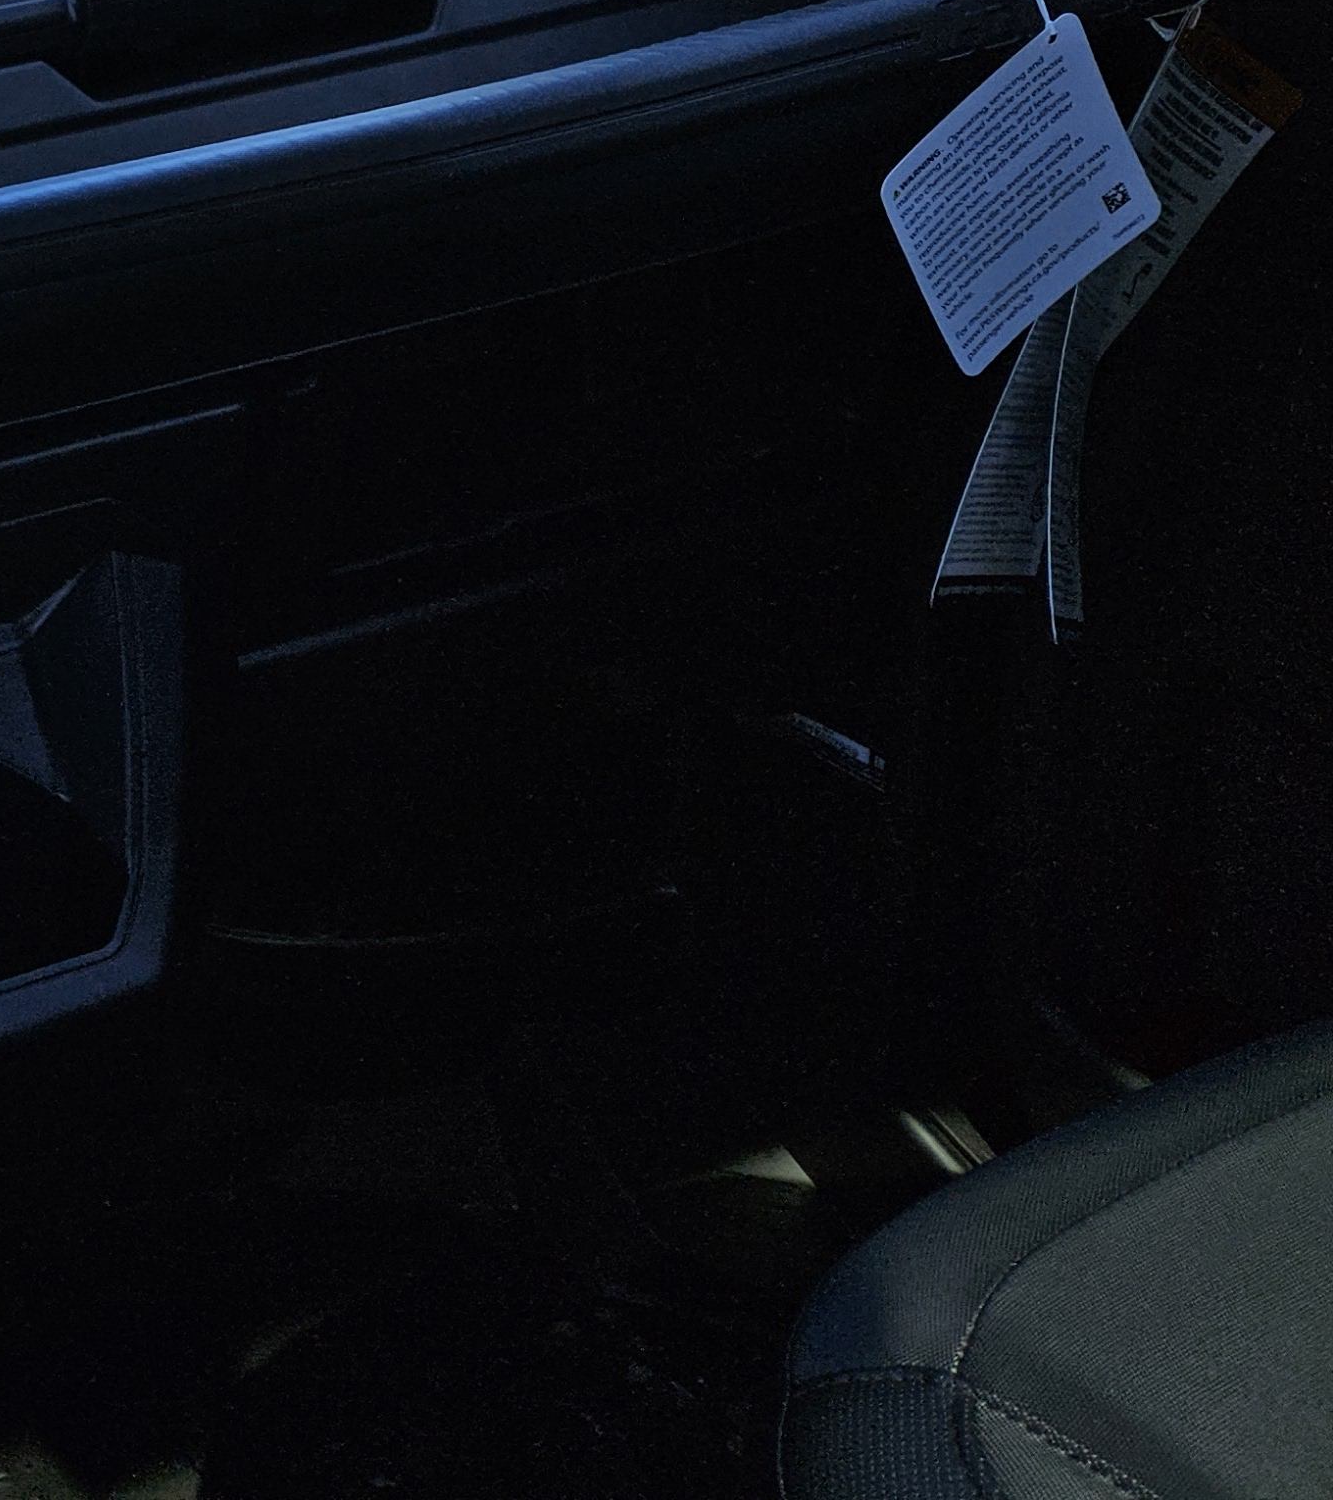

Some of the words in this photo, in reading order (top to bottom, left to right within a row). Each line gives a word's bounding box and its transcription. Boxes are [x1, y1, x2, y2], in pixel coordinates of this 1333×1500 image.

[895, 162, 942, 210] maintaining
[985, 95, 1015, 123] vehicle
[1014, 81, 1032, 97] can
[1031, 55, 1064, 83] expose
[988, 71, 1027, 106] servicing
[1026, 54, 1045, 74] and
[899, 203, 915, 221] you
[923, 156, 964, 195] chemicals
[963, 121, 1002, 159] including
[1001, 95, 1031, 123] engine
[904, 201, 932, 230] carbon
[1016, 105, 1034, 125] and
[909, 215, 933, 240] which
[932, 201, 946, 217] are
[944, 175, 974, 203] known
[982, 153, 998, 169] the
[997, 133, 1020, 155] State
[1029, 91, 1071, 127] California
[923, 217, 945, 241] cause
[944, 191, 971, 219] cancer
[971, 174, 989, 194] and
[987, 158, 1010, 179] birth
[1008, 131, 1040, 160] defects
[1049, 101, 1073, 124] other
[932, 223, 968, 260] minimize
[1005, 166, 1030, 192] avoid
[1028, 132, 1071, 170] breathing
[968, 225, 998, 253] service
[997, 207, 1017, 229] your
[1016, 182, 1047, 210] vehicle
[969, 222, 985, 238] not
[983, 208, 1001, 225] idle
[999, 195, 1016, 210] the
[1015, 169, 1045, 197] engine
[1044, 143, 1074, 172] except
[992, 228, 1011, 247] area
[1011, 211, 1028, 231] and
[1026, 194, 1049, 215] wear
[1048, 171, 1076, 199] gloves
[1085, 144, 1111, 165] wash
[918, 210, 966, 260] reproductive
[940, 290, 958, 312] your
[957, 267, 984, 293] hands
[982, 230, 1024, 269] frequently
[1024, 209, 1049, 232] when
[1048, 177, 1087, 211] servicing
[1085, 160, 1107, 182] your
[954, 325, 969, 341] For
[968, 305, 989, 327] more
[988, 263, 1037, 306] information
